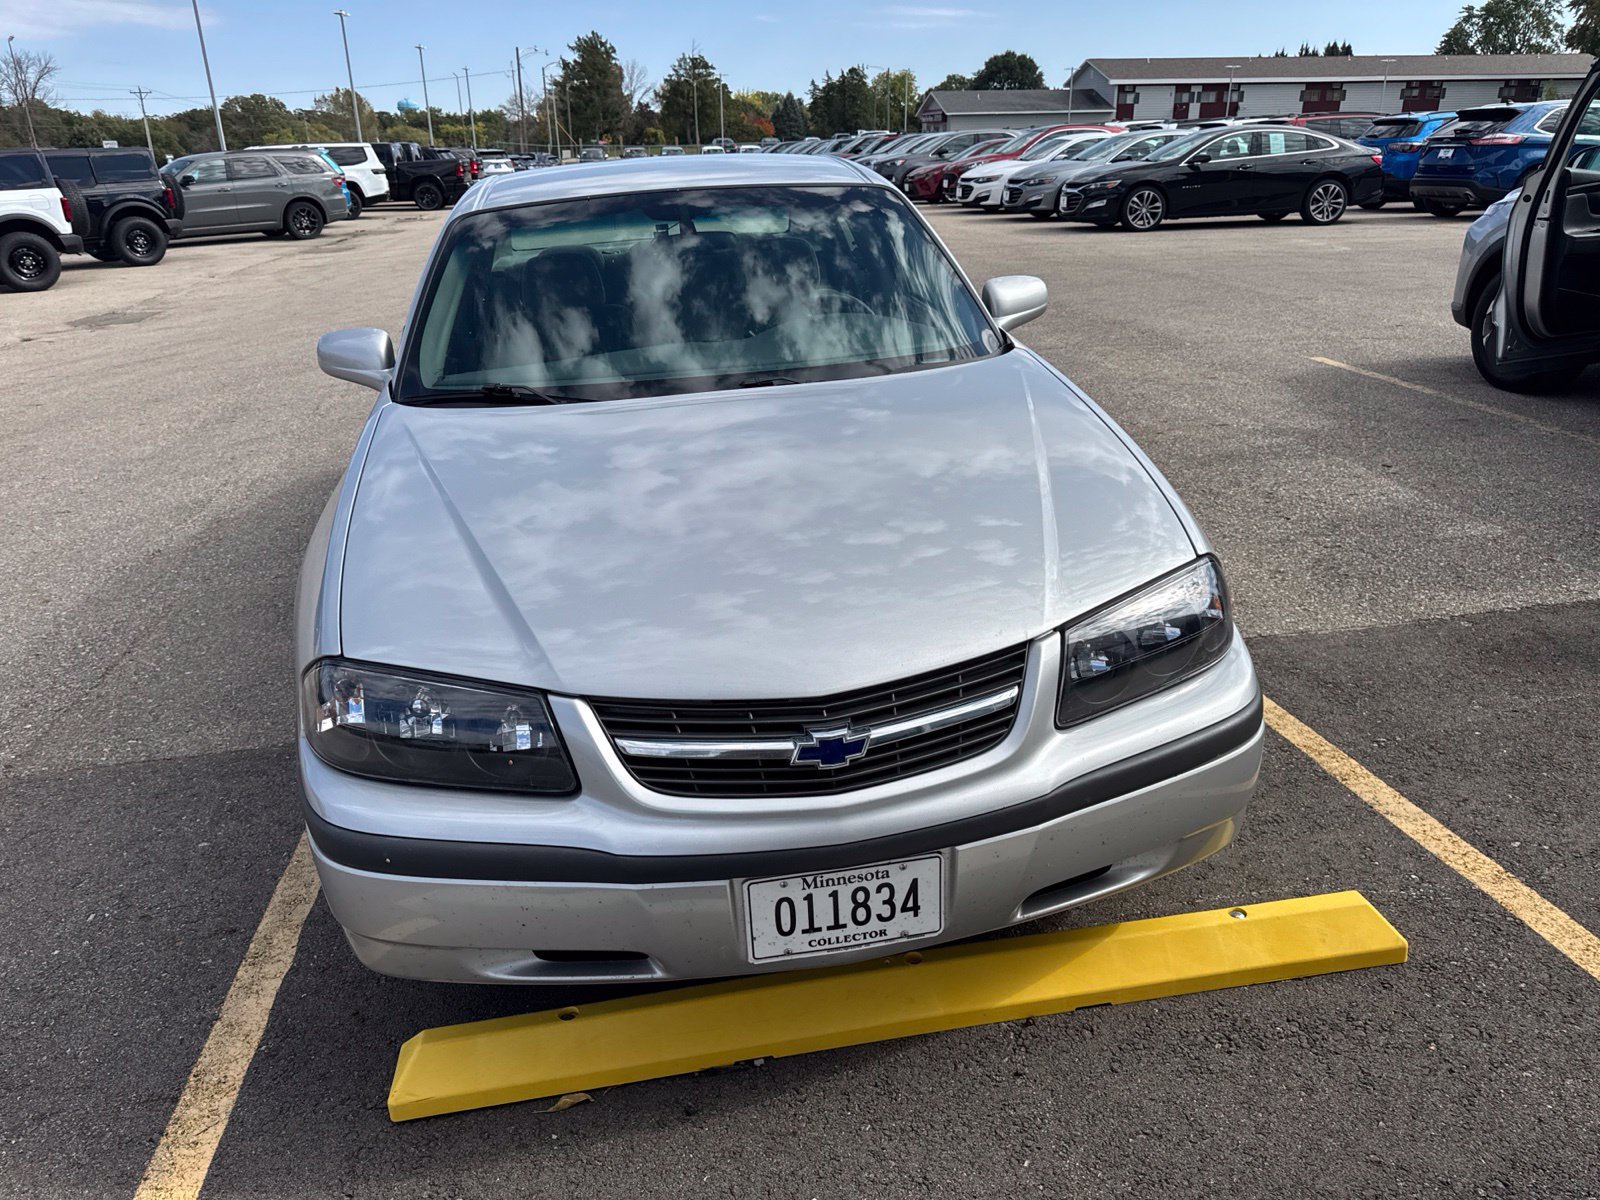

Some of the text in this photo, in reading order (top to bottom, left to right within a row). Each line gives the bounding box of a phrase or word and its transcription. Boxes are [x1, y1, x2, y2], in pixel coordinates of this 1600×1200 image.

[801, 869, 890, 891] Minnesota
[775, 877, 921, 937] 011834
[808, 928, 888, 948] COLLECTOR
